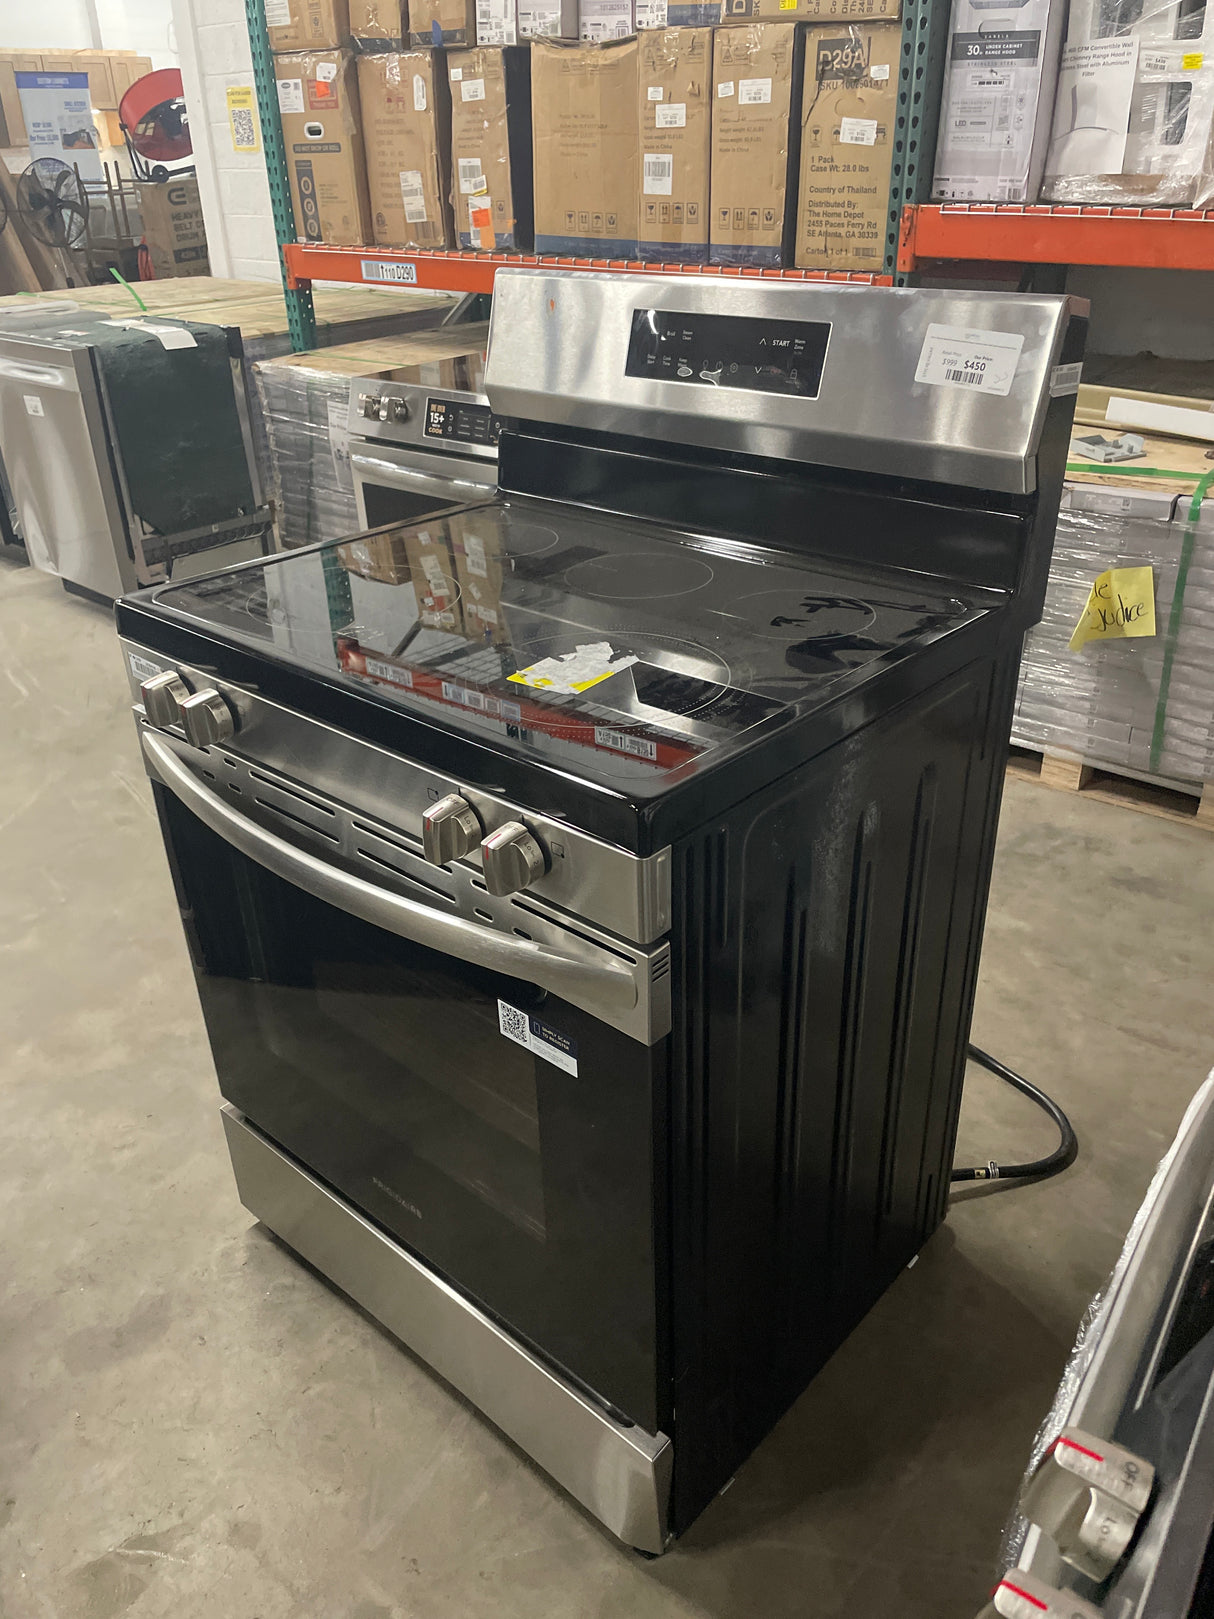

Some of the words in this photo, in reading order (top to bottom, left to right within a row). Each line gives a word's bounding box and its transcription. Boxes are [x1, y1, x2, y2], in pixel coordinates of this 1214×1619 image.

[1090, 43, 1121, 51] Convertible
[818, 47, 866, 70] D29A
[1092, 53, 1110, 61] Range
[818, 155, 835, 164] Pack
[810, 164, 828, 173] Case
[858, 164, 870, 173] lbs
[809, 185, 836, 195] Country
[838, 185, 846, 194] of
[847, 185, 877, 194] Thailand
[808, 199, 845, 209] Distributed
[808, 209, 821, 218] The
[822, 210, 842, 219] Home
[843, 210, 865, 220] Depot
[807, 220, 823, 228] 2455
[825, 220, 845, 229] Paces
[847, 221, 865, 231] Ferry
[866, 221, 878, 229] Rd
[807, 229, 817, 238] SE
[845, 230, 856, 239] GA
[857, 231, 879, 239] 30339
[396, 265, 414, 281] D290
[772, 339, 790, 347] START
[963, 359, 987, 372] $450
[430, 412, 445, 424] 15+
[428, 426, 443, 435] COOK
